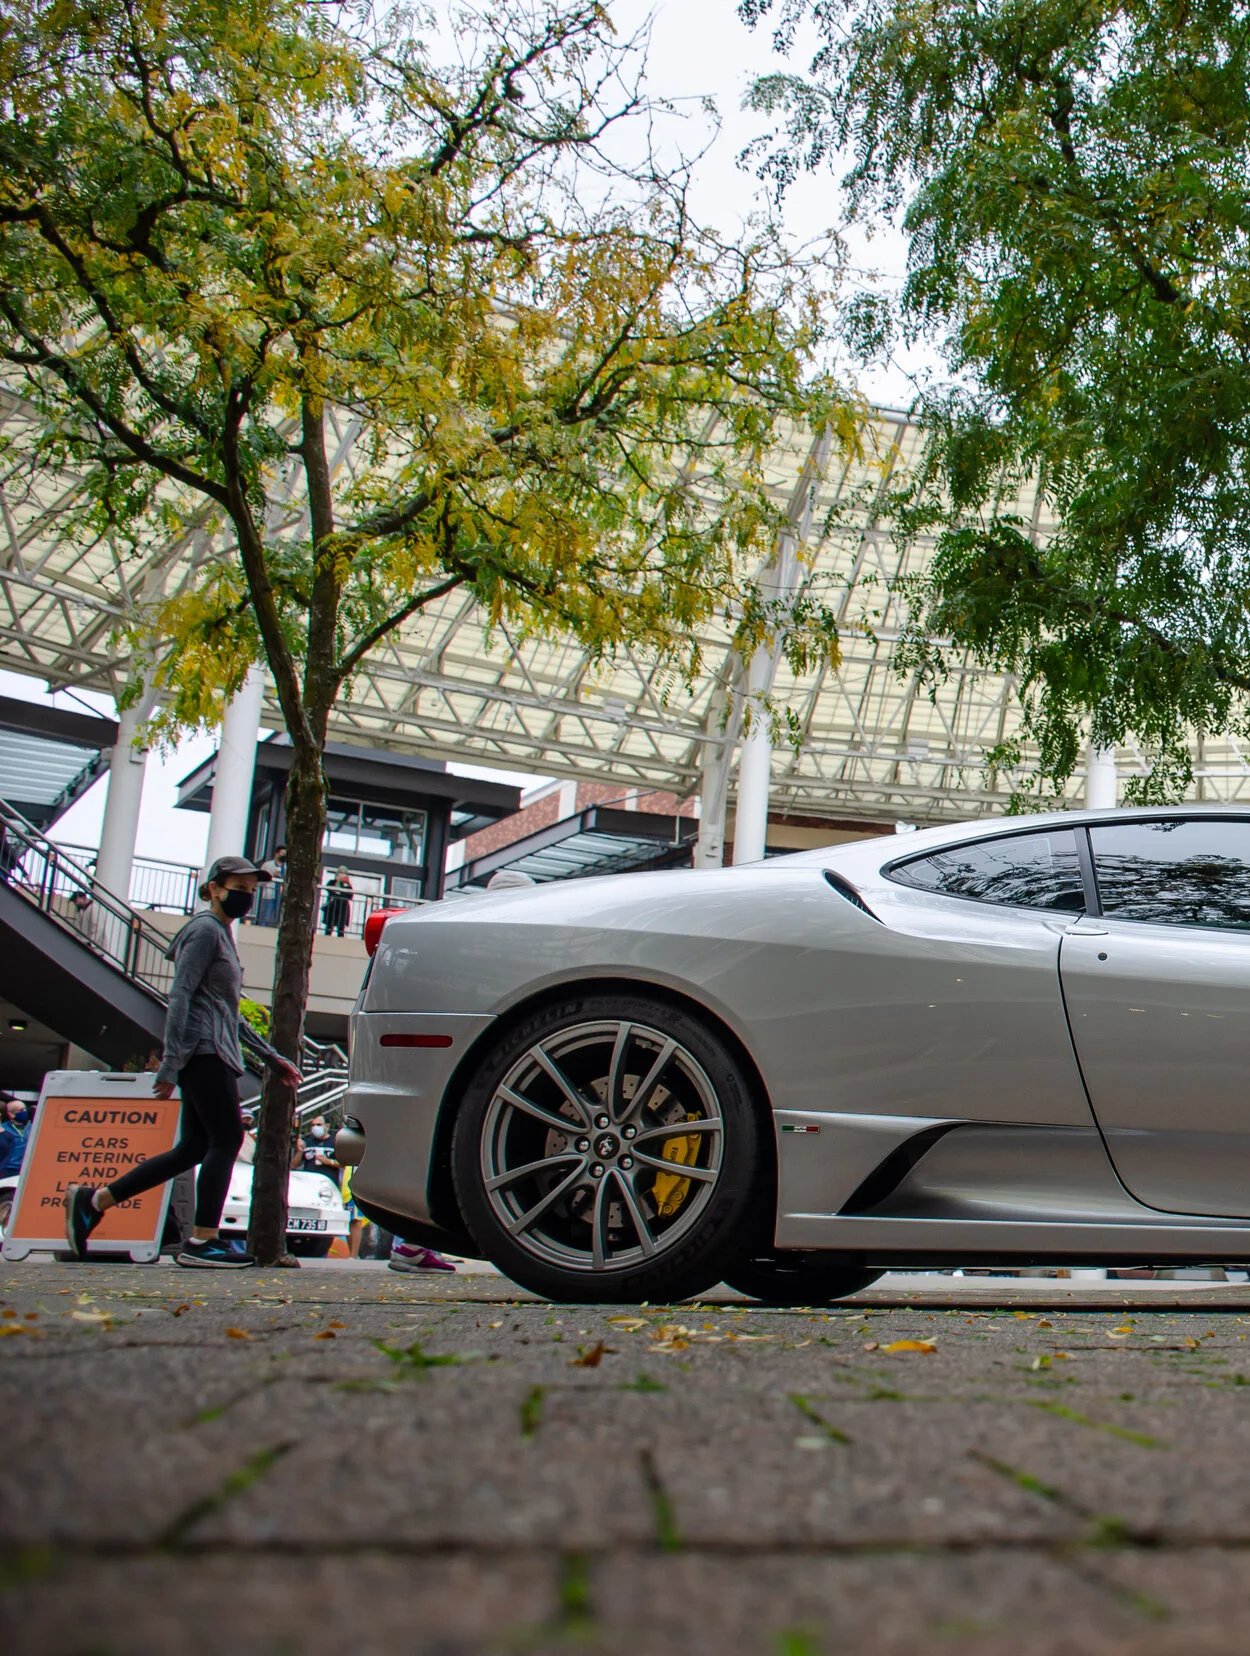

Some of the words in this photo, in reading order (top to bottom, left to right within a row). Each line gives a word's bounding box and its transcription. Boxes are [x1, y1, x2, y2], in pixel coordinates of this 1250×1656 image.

[64, 1110, 158, 1125] CAUTION
[81, 1137, 128, 1149] CARS
[56, 1151, 146, 1164] ENTERING
[78, 1167, 118, 1179] AND
